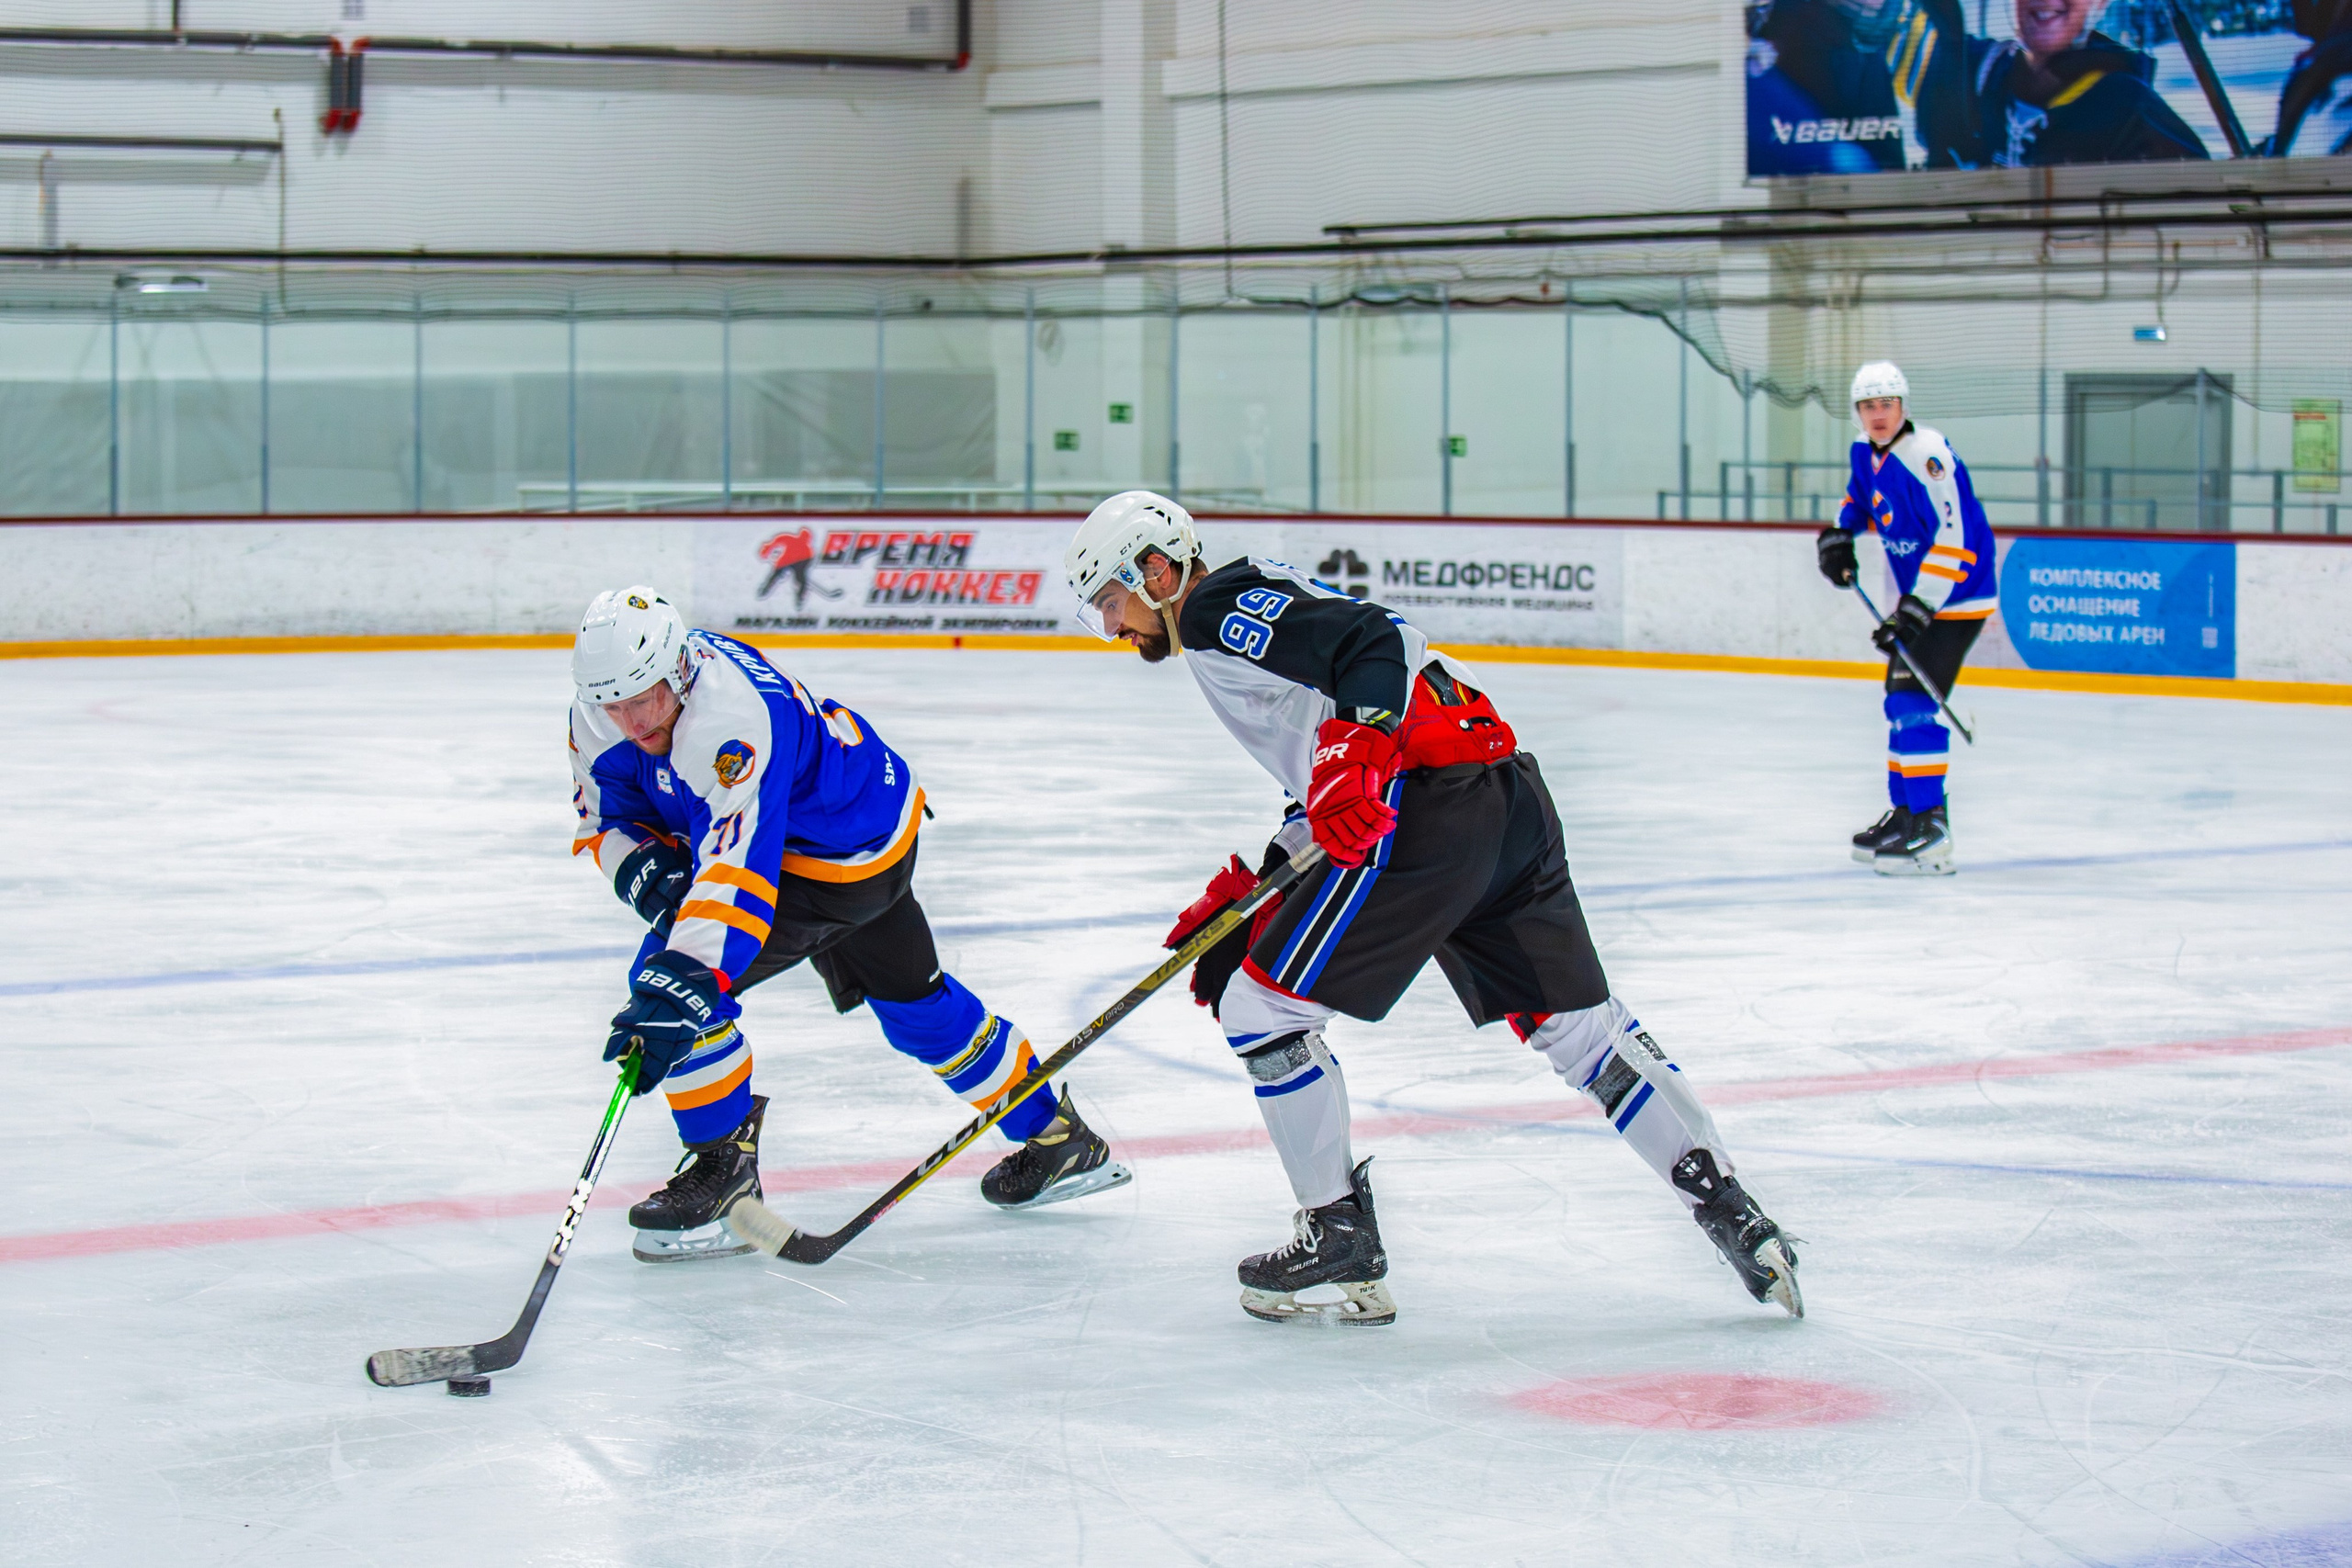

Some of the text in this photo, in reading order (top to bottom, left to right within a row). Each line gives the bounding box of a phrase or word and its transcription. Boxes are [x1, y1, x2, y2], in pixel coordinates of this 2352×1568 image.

[1795, 117, 1901, 143] BAUER
[820, 531, 976, 567] ВРЕМЯ
[866, 570, 1042, 606] ХОККЕЯ
[1383, 560, 1595, 591] МЕДФРЕНДС
[2029, 568, 2161, 591] КОМПЛЕКСНОЕ
[2029, 594, 2141, 618] ОСНАЩЕНИЕ
[1219, 588, 1295, 660] 99
[2029, 621, 2165, 646] ЛЕДОВЫХ АРЕН
[588, 679, 616, 688] BAUER
[636, 969, 712, 1022] BAUER
[1104, 1001, 1125, 1021] PRO
[917, 1090, 1010, 1178] CCM
